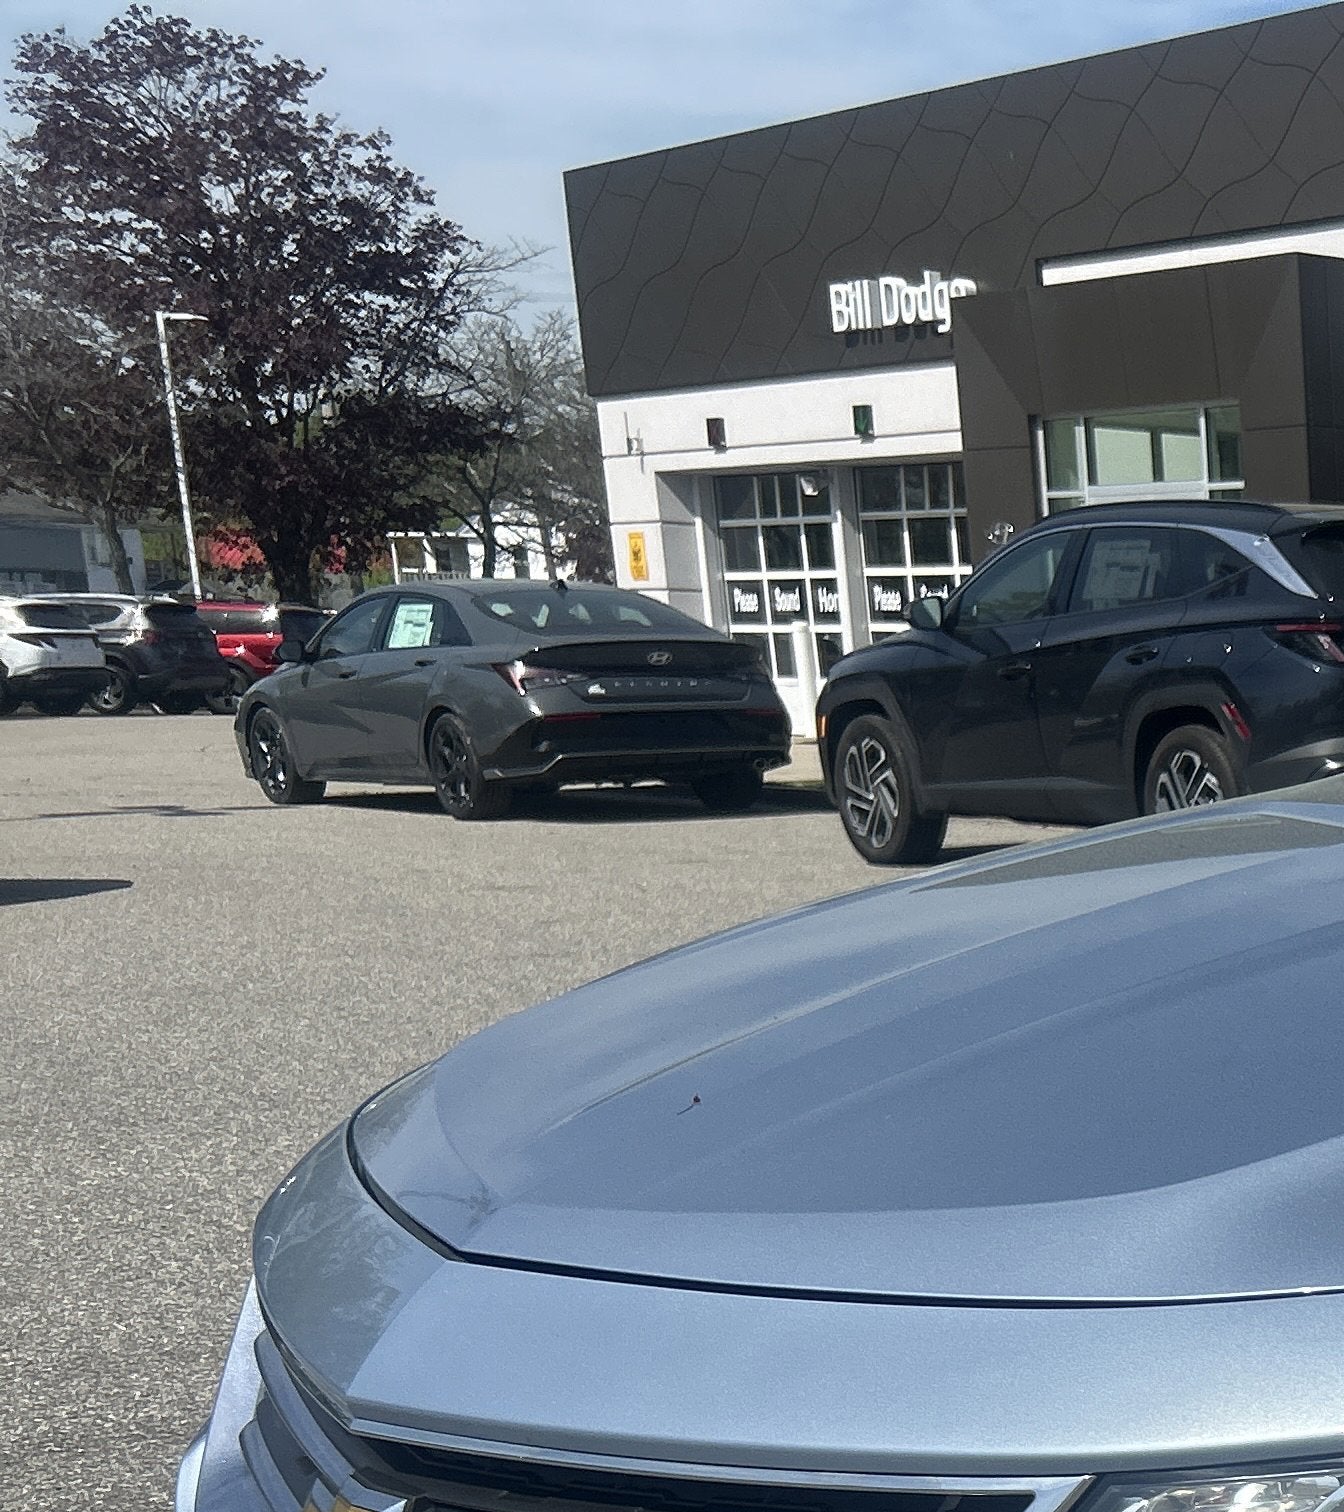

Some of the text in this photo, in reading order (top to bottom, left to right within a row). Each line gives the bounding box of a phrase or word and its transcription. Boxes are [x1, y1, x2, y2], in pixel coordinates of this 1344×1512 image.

[829, 279, 875, 333] Bill
[733, 587, 759, 613] Please
[774, 587, 801, 612] Sound
[873, 584, 902, 612] Please
